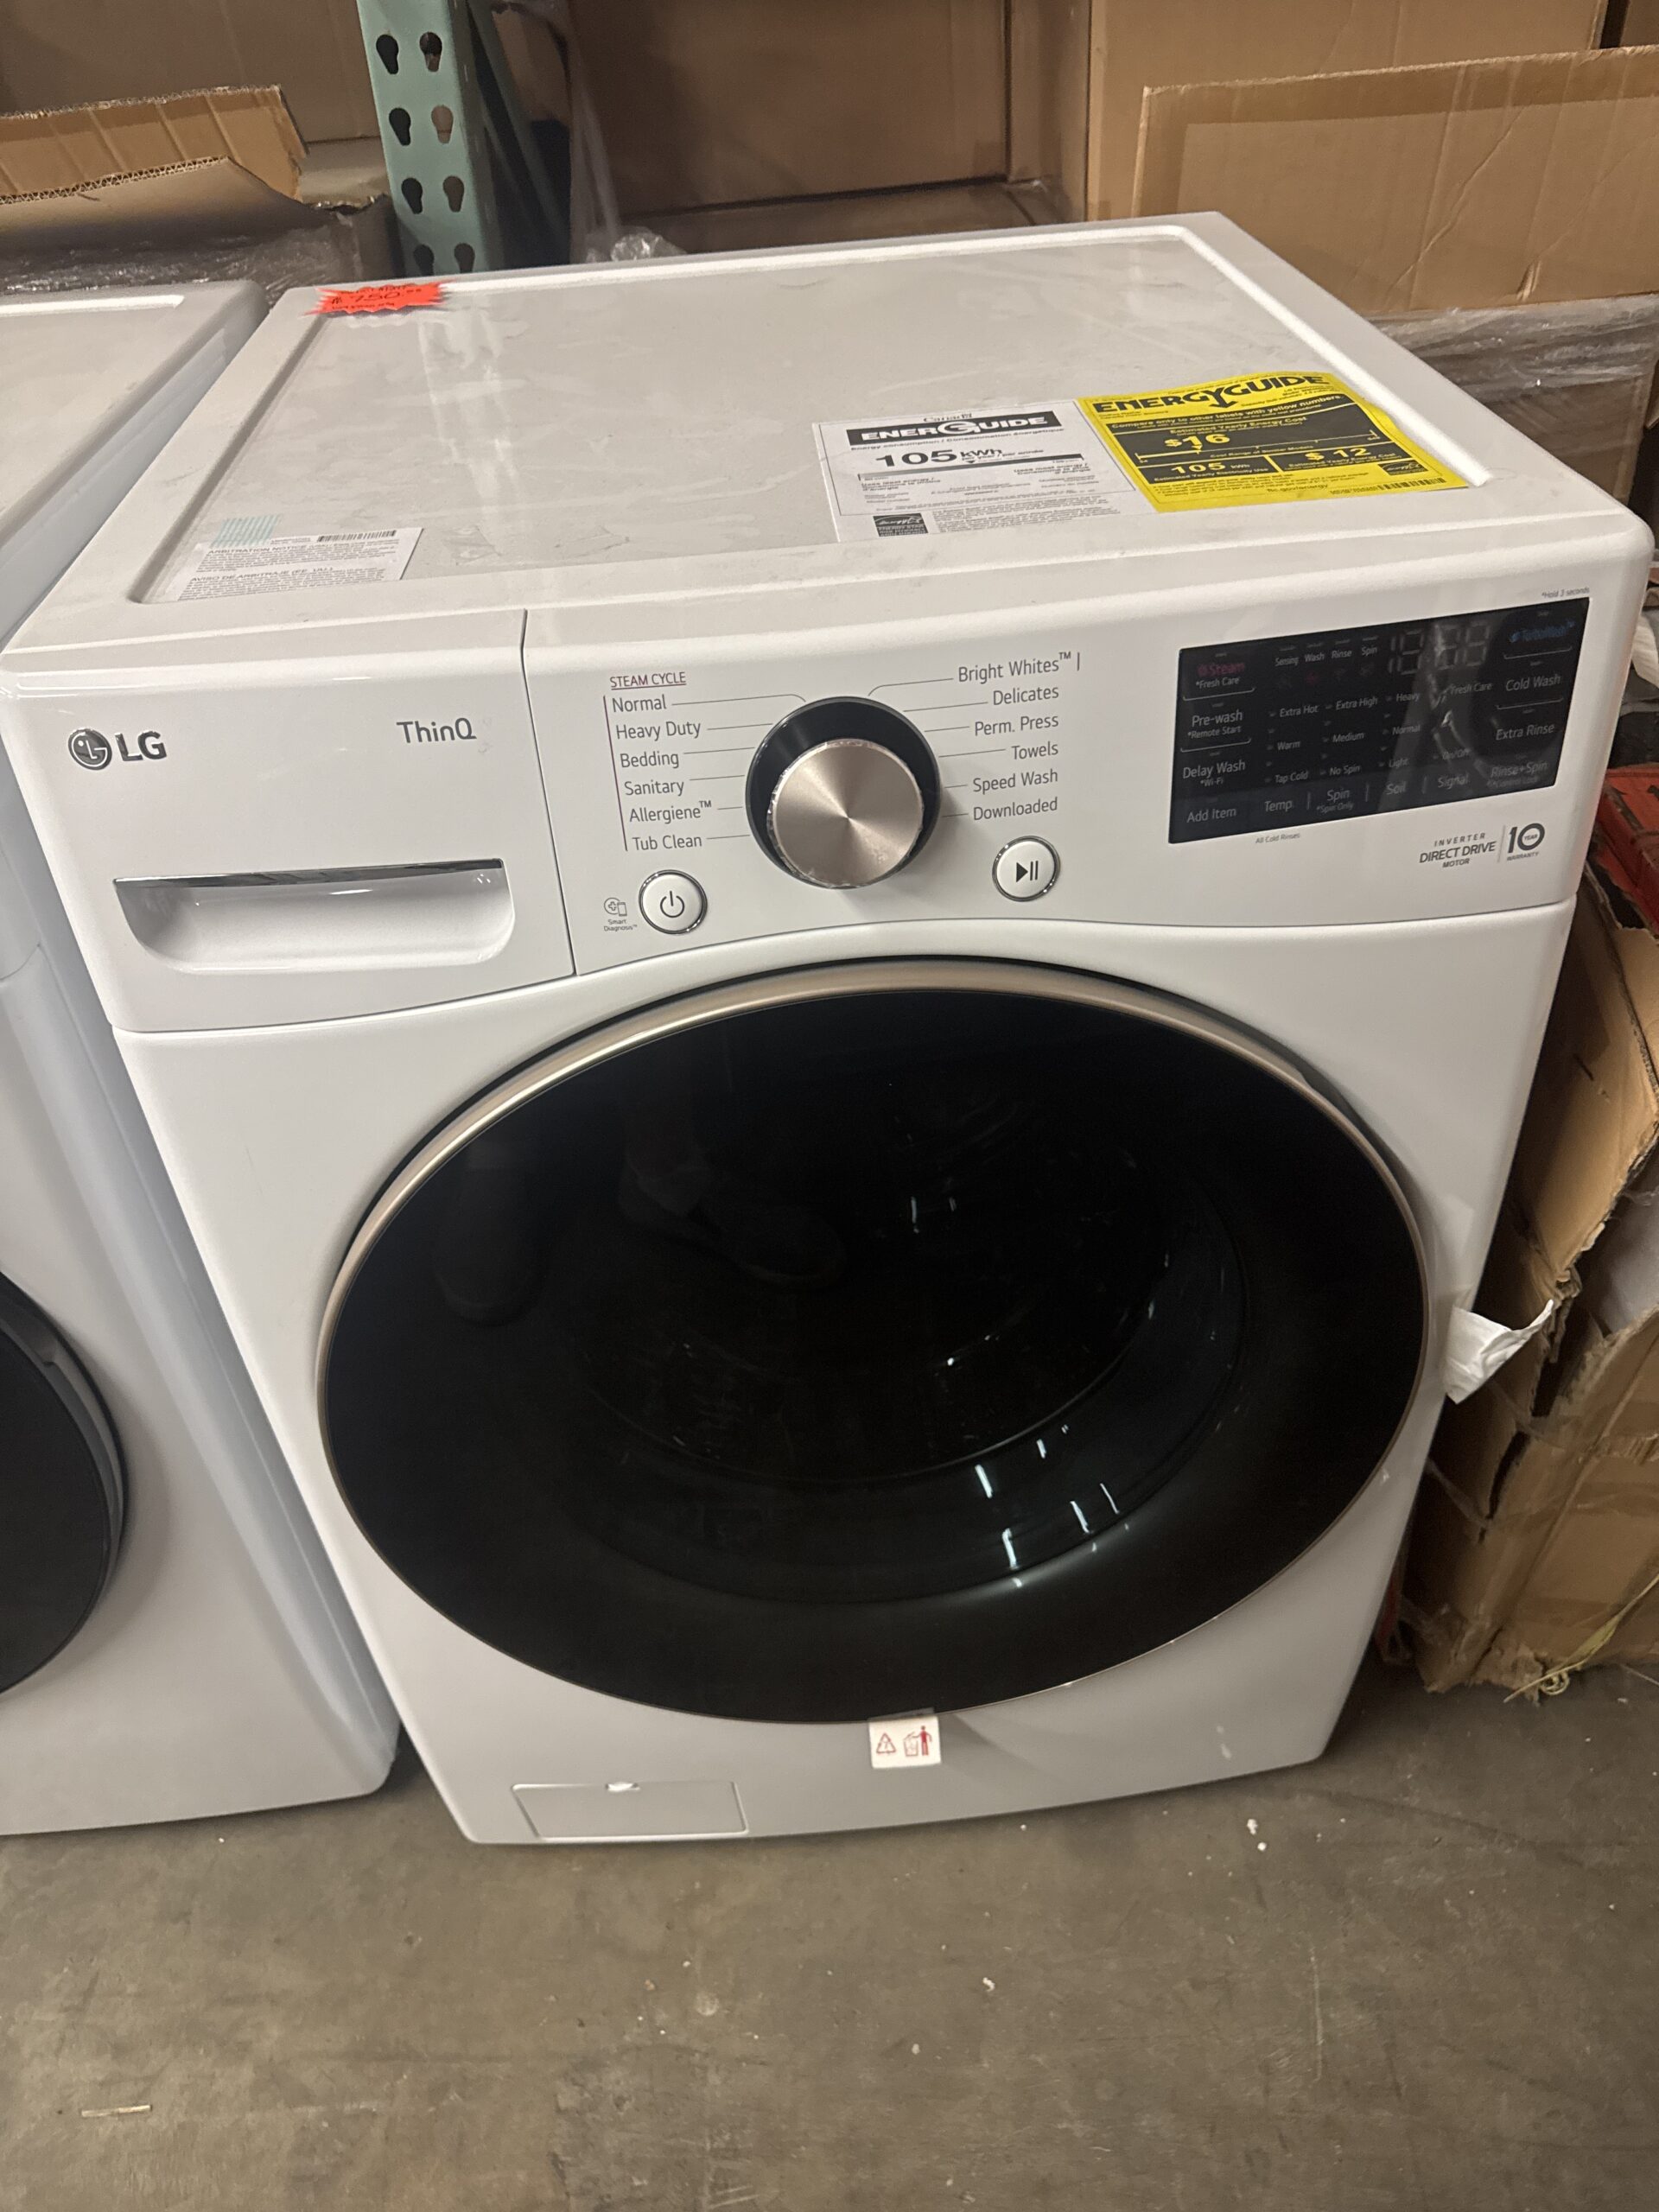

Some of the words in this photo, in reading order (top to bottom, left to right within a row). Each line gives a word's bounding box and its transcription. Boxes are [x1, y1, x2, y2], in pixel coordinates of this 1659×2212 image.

[1092, 375, 1330, 413] ENERGYGUIDE
[1268, 403, 1298, 413] yellow
[861, 416, 1048, 441] ENERGUIDE
[1164, 433, 1230, 448] $16
[875, 449, 957, 467] 105
[960, 448, 1002, 457] kWh
[1171, 462, 1226, 474] 105
[1304, 652, 1325, 663] Wash
[1332, 649, 1352, 659] Rinse
[1361, 645, 1378, 657] Spin
[610, 673, 649, 688] STEAM
[652, 671, 687, 686] CYCLE
[957, 664, 1003, 684] Bright
[1222, 676, 1240, 687] Care
[1506, 677, 1529, 692] Cold
[1533, 674, 1561, 689] Wash
[992, 684, 1059, 706] Delicates
[1396, 691, 1420, 703] Heavy
[612, 695, 666, 713] Normal
[1279, 707, 1301, 718] Extra
[1303, 704, 1319, 715] Hot
[1335, 699, 1357, 711] Extra
[1358, 696, 1378, 709] High
[974, 718, 1015, 736] Perm.
[1020, 714, 1059, 732] Press
[1192, 709, 1243, 728] Pre-wash
[396, 717, 477, 744] ThinQ
[615, 722, 661, 743] Heavy
[665, 720, 701, 741] Duty
[1222, 724, 1242, 735] Start
[1332, 731, 1364, 744] Medium
[1392, 724, 1421, 735] Normal
[1496, 727, 1524, 741] Extra
[1527, 723, 1555, 737] Rinse
[115, 729, 167, 762] LG
[1011, 741, 1058, 760] Towels
[1276, 740, 1301, 751] Warm
[620, 751, 679, 770] Bedding
[1389, 757, 1409, 768] Light
[1183, 762, 1214, 779] Delay
[1216, 759, 1246, 774] Wash
[1329, 766, 1342, 776] No
[1343, 763, 1361, 776] Spin
[973, 773, 1016, 794] Speed
[1020, 769, 1058, 787] Wash
[1274, 773, 1288, 785] Tap
[1289, 770, 1309, 782] Cold
[1437, 774, 1469, 790] Signal
[624, 779, 684, 799] Sanitary
[1326, 788, 1351, 804] Spin
[1385, 781, 1407, 796] Soil
[973, 798, 1058, 821] Downloaded
[1264, 798, 1293, 813] Temp
[1187, 809, 1209, 823] Add
[1211, 805, 1237, 819] Item
[632, 835, 660, 851] Tub
[664, 833, 702, 849] Clean
[1433, 832, 1486, 848] INVERTER
[1507, 823, 1546, 854] 10
[1419, 847, 1461, 863] DIRECT
[1462, 841, 1497, 856] DRIVE
[1506, 851, 1540, 861] WARRANTY
[1442, 858, 1471, 868] MOTOR
